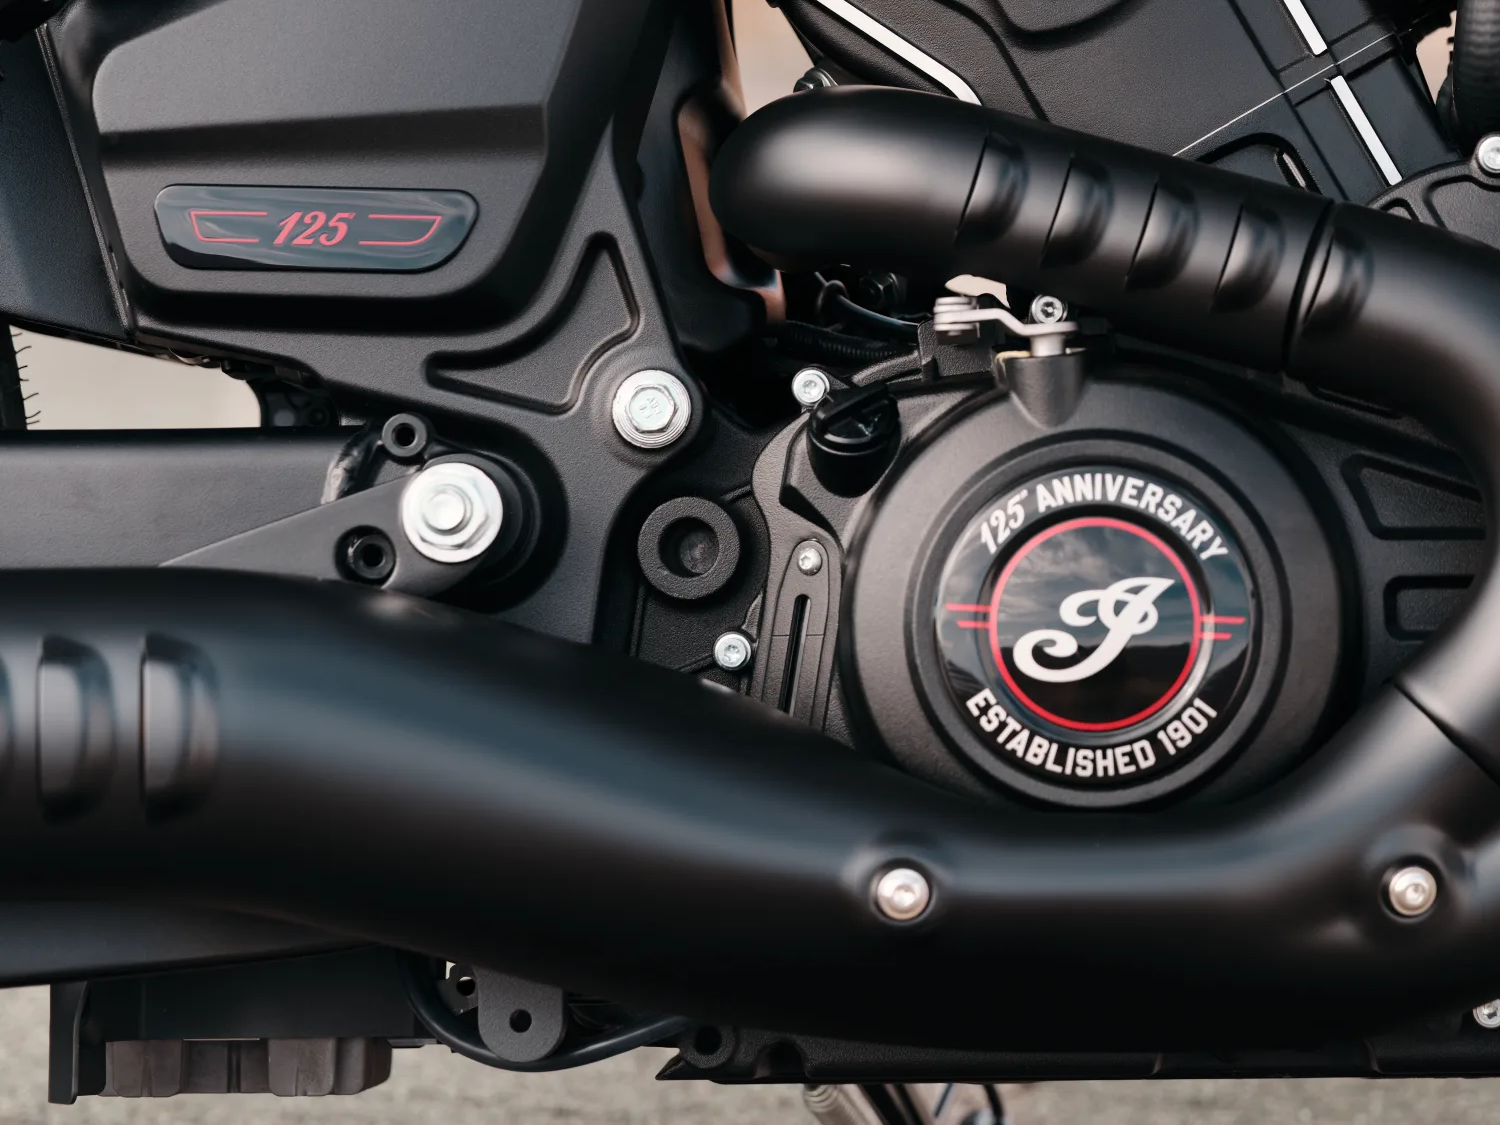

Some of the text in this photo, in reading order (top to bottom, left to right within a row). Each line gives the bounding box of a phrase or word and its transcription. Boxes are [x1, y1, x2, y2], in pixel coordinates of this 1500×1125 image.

[273, 210, 356, 247] 125
[1035, 473, 1229, 561] ANNIVERSARY
[965, 687, 1218, 778] ESTABLISHED 1901
